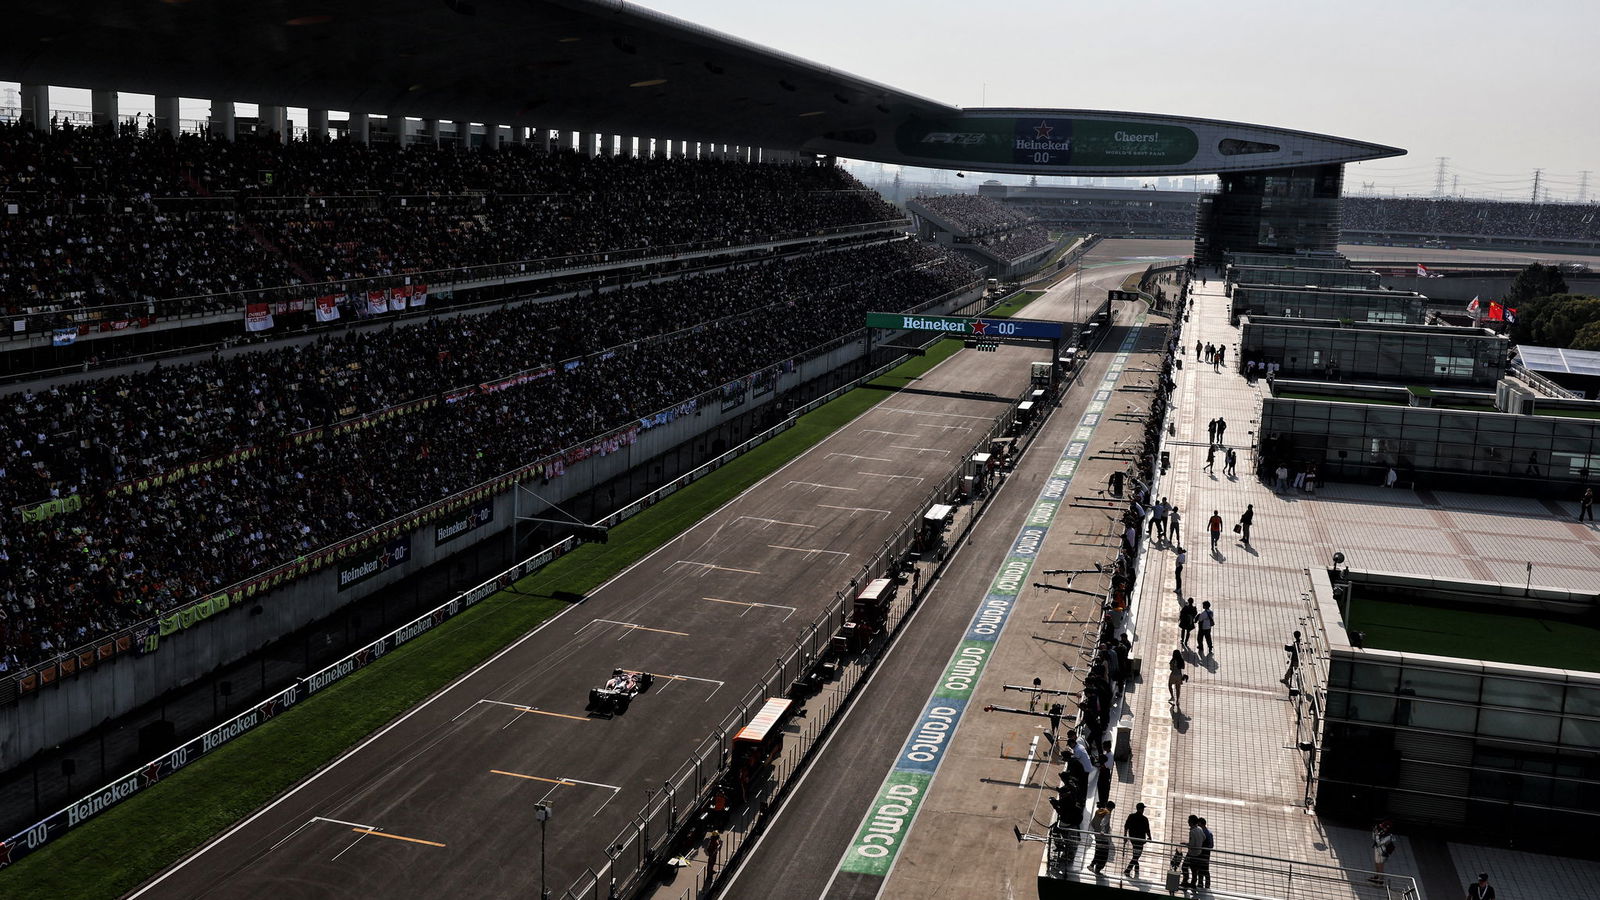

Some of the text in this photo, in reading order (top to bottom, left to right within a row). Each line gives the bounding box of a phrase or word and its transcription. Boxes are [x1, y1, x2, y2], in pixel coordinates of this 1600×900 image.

[1016, 139, 1069, 150] Heineken
[1114, 131, 1158, 142] Cheers!
[1034, 152, 1049, 163] 0.0
[903, 316, 1015, 335] Heineken 0.0
[438, 521, 468, 541] Heineken
[341, 560, 378, 585] Heineken
[525, 551, 553, 573] Heineken
[997, 561, 1027, 590] aramco
[466, 580, 497, 607] Heineken
[395, 616, 432, 646] Heineken
[974, 600, 1009, 635] aramco
[308, 657, 354, 694] Heineken
[945, 647, 985, 691] aramco
[202, 712, 258, 753] Heineken
[907, 706, 956, 762] aramco
[68, 747, 187, 828] Heineken 0.0
[857, 784, 918, 858] aramco
[27, 823, 48, 849] 0.0
